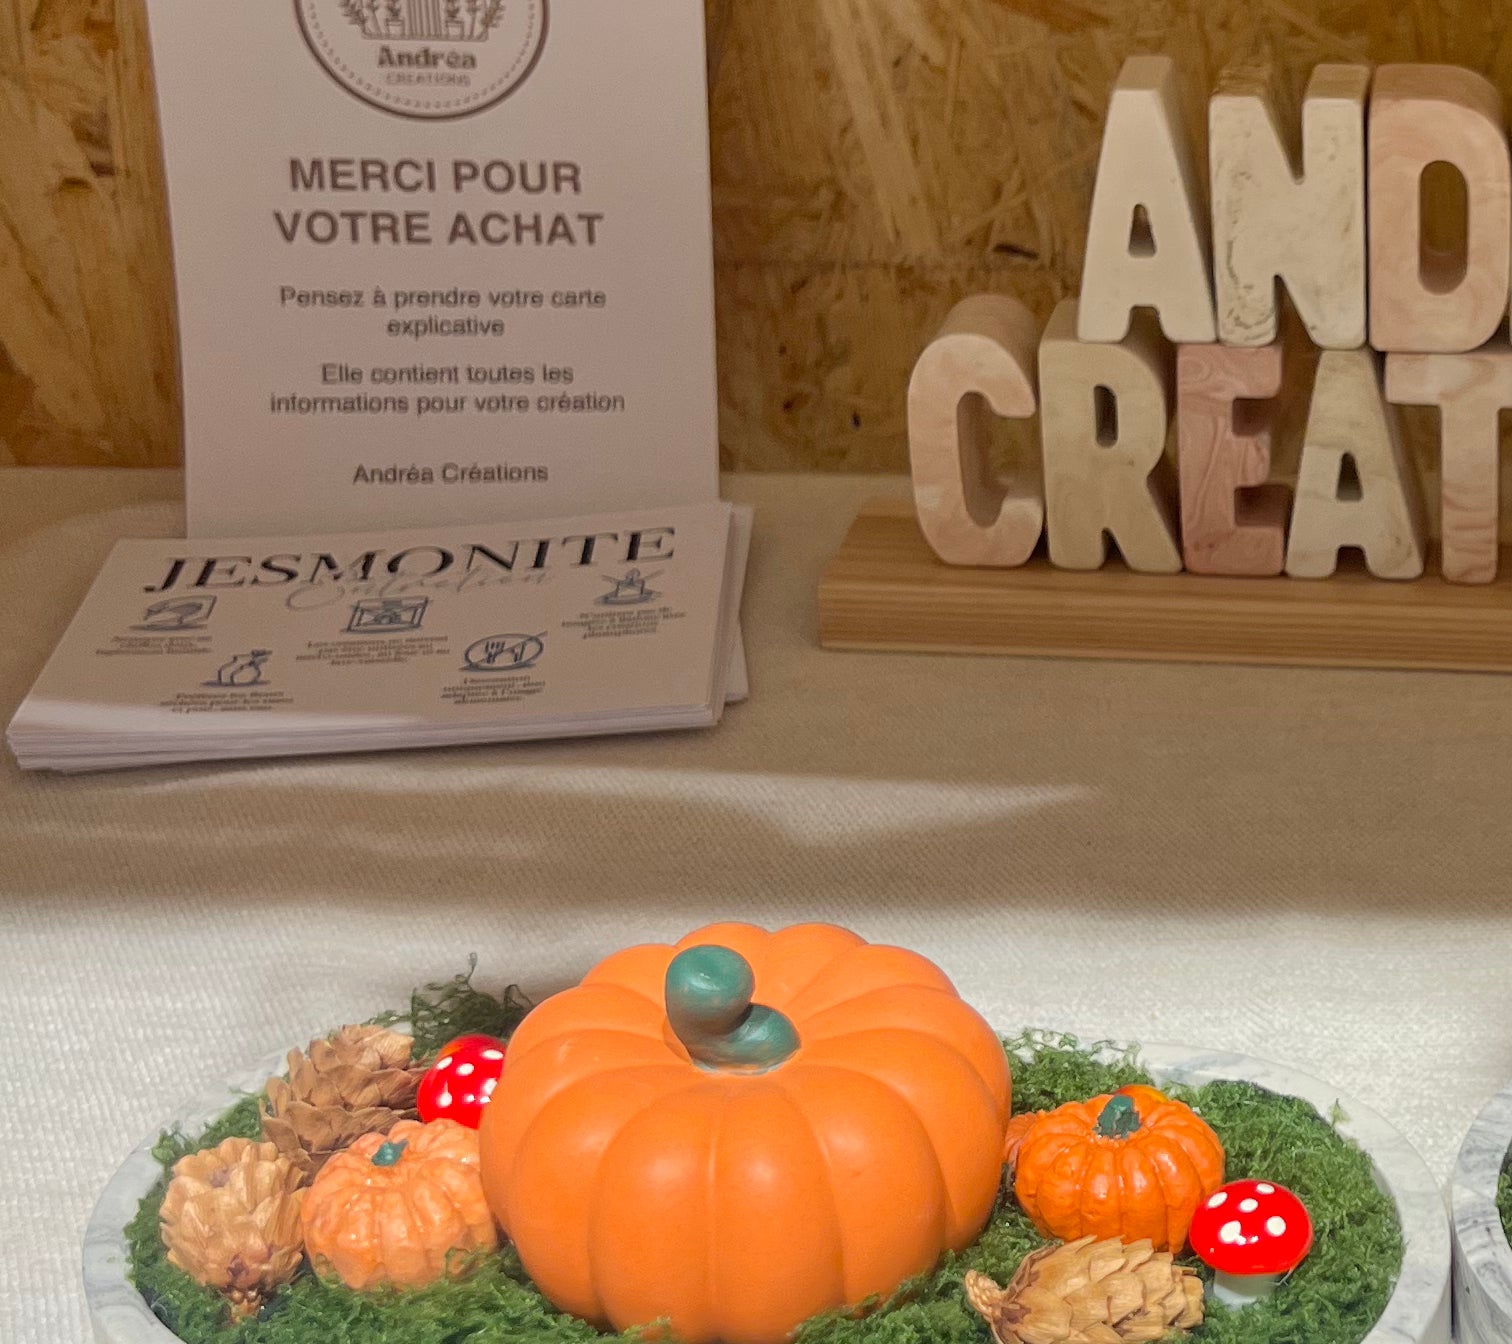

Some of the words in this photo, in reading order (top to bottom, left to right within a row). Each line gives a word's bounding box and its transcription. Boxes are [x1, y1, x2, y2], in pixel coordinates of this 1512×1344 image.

[289, 158, 436, 193] MERCI
[453, 159, 582, 195] POUR
[274, 210, 432, 245] VOTRE
[448, 212, 604, 247] ACHAT
[279, 285, 364, 308] Pensez
[373, 285, 387, 307] à
[394, 286, 481, 311] prendre
[488, 288, 544, 308] votre
[551, 288, 607, 309] carte
[387, 315, 505, 341] explicative
[321, 363, 363, 385] Elle
[370, 363, 459, 385] contient
[466, 363, 535, 385] toutes
[542, 364, 574, 385] les
[270, 392, 409, 415] informations
[416, 396, 466, 417] pour
[474, 395, 530, 414] votre
[536, 391, 626, 414] création
[352, 463, 434, 485] Andréa
[441, 462, 549, 484] Créations
[142, 526, 676, 595] JESMONITE
